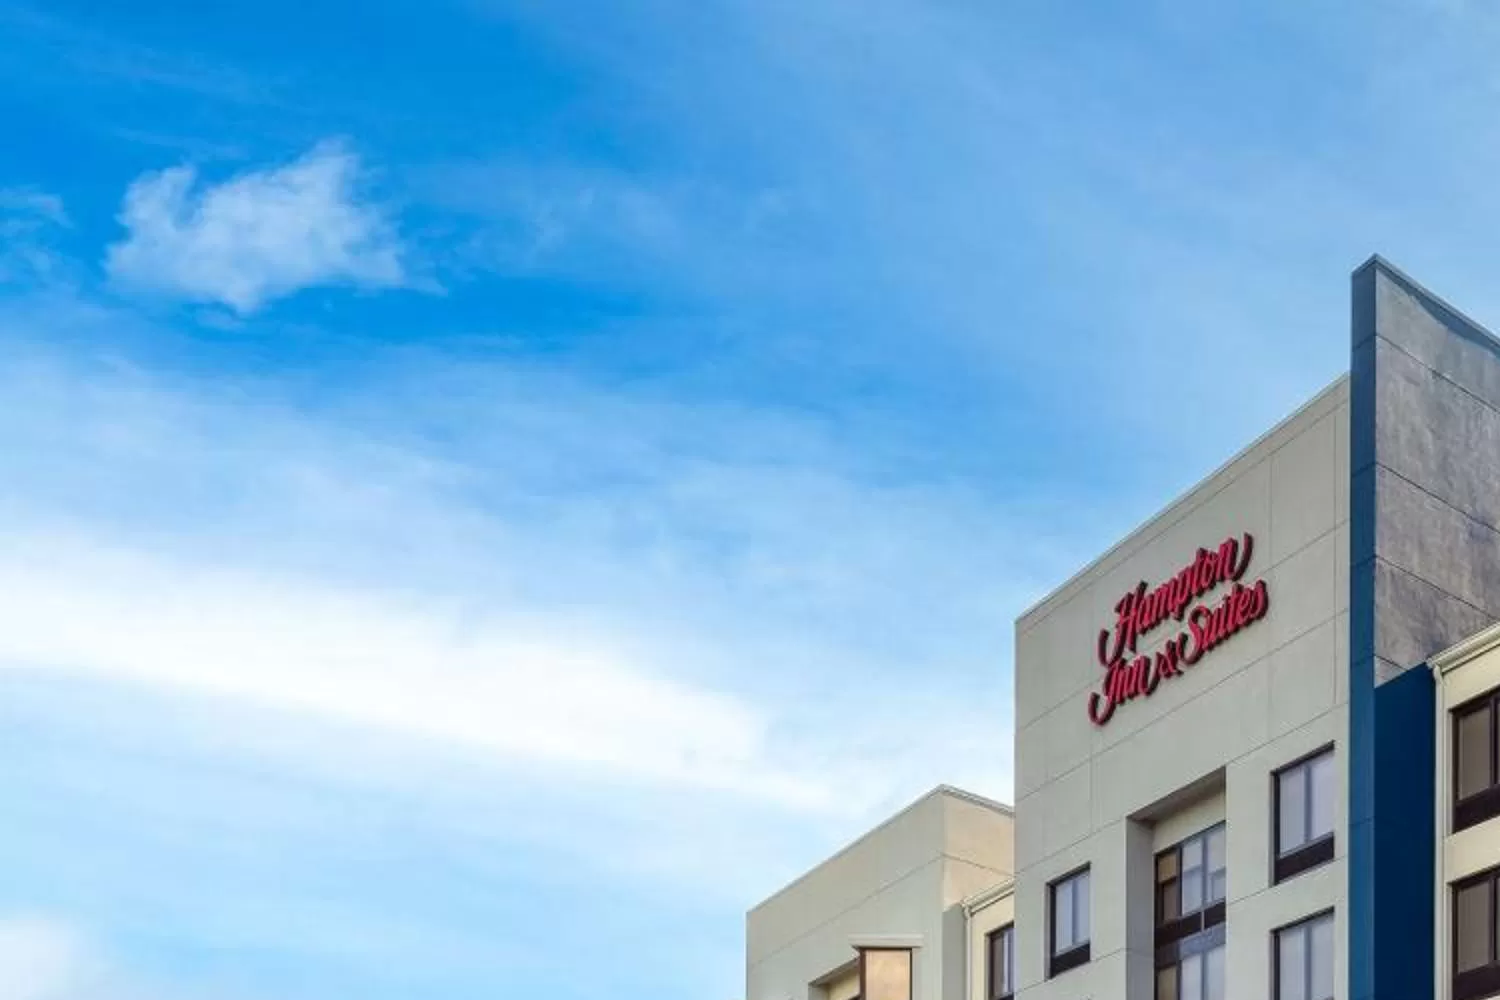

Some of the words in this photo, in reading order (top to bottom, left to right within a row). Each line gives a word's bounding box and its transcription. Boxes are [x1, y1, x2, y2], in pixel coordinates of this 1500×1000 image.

[1088, 655, 1160, 726] Inn
[1176, 579, 1269, 665] Suites
[1098, 532, 1254, 668] Hampton
